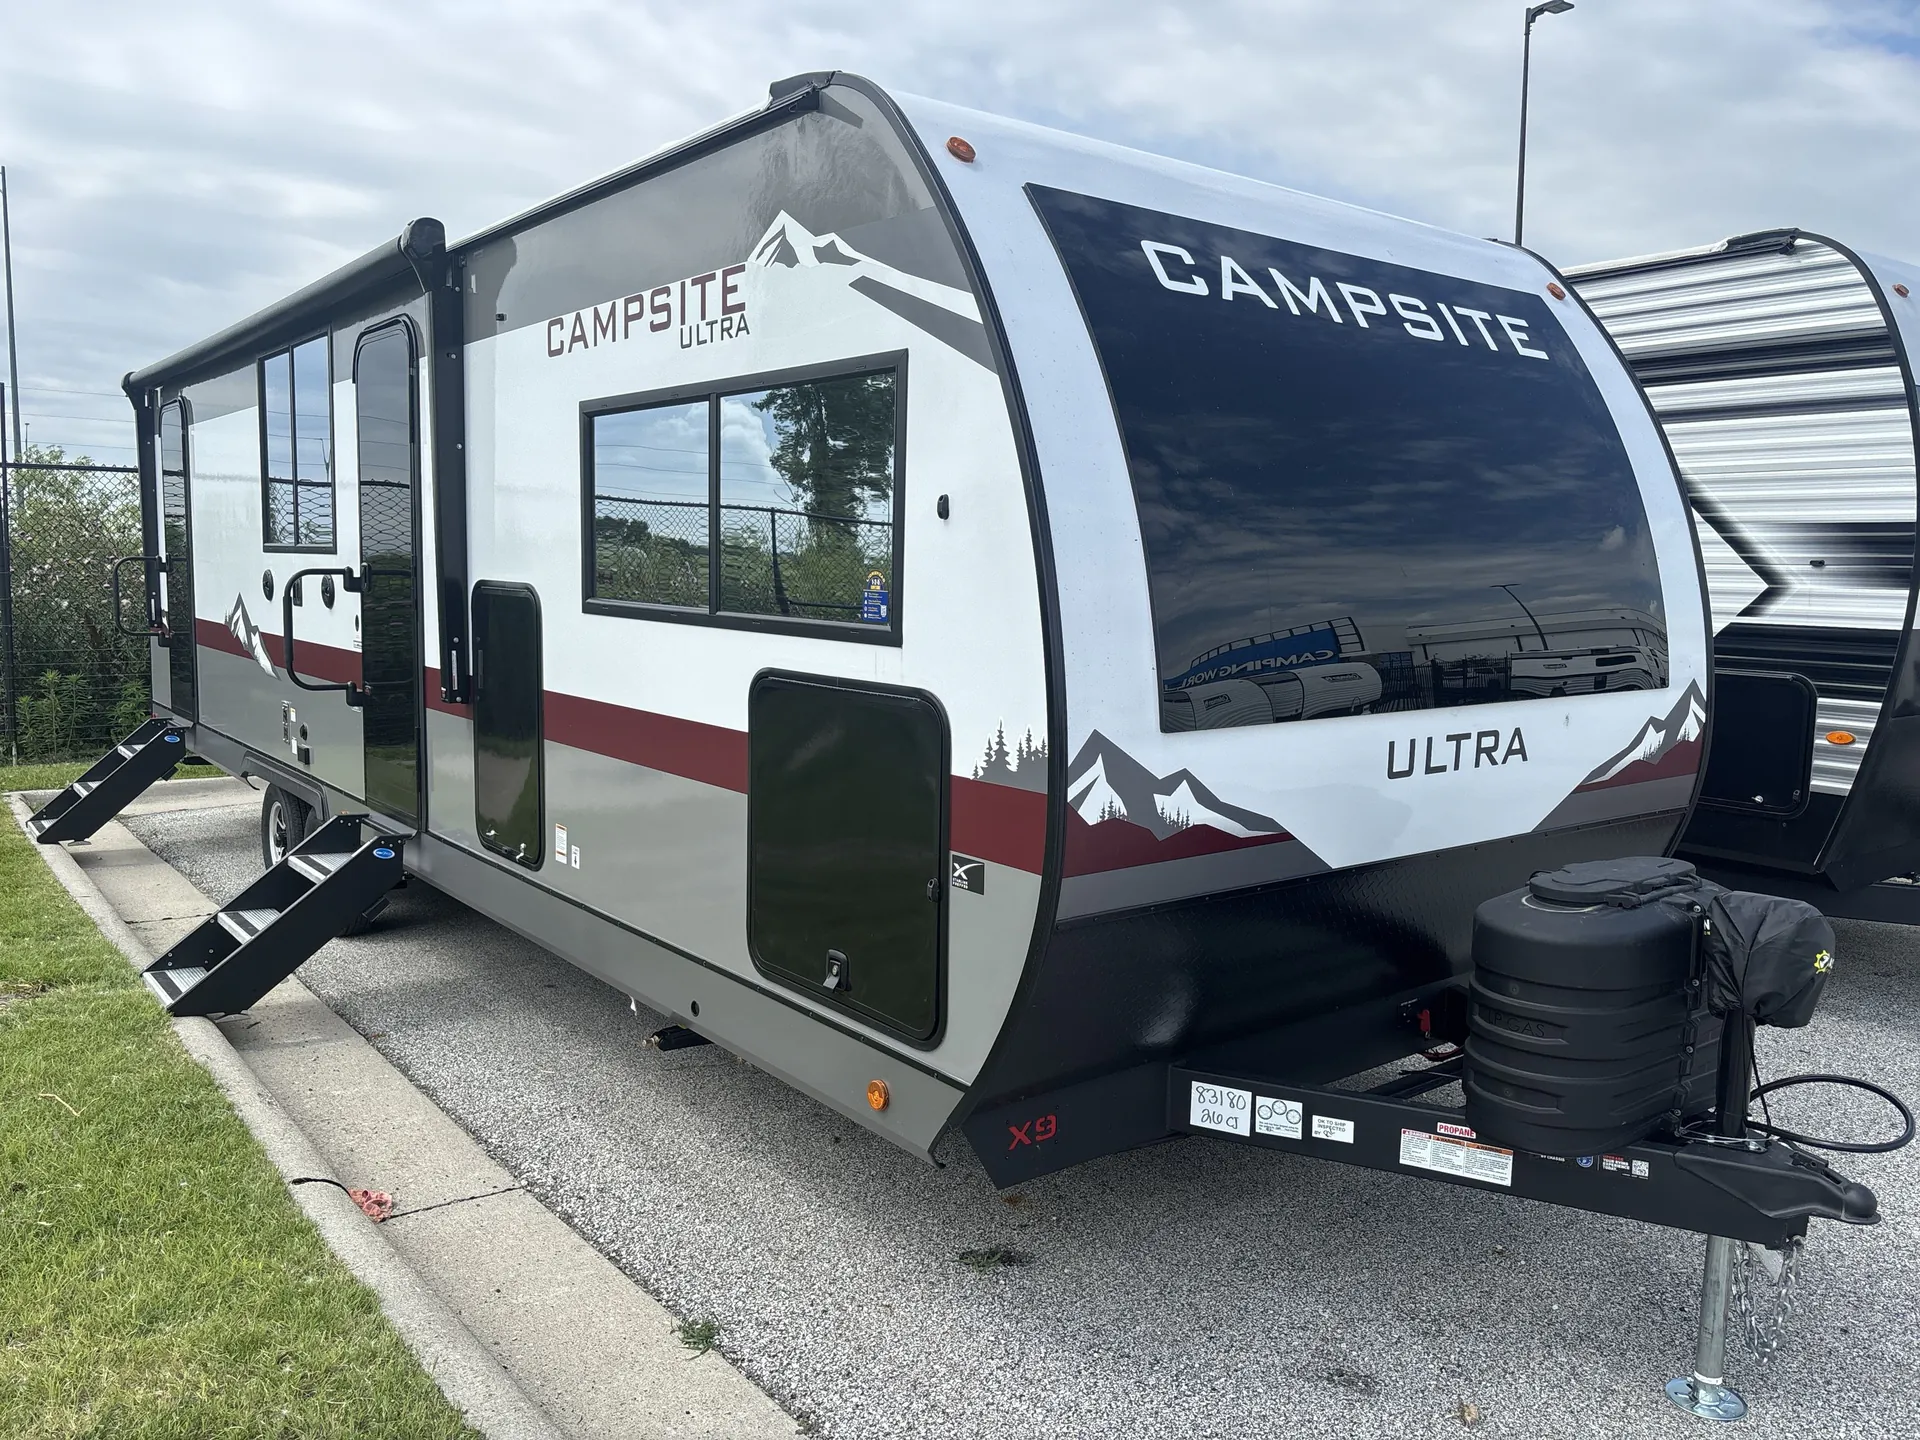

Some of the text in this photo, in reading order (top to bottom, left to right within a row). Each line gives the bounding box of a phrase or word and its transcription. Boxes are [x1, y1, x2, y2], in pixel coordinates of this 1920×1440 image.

[547, 263, 747, 358] CAMPSITE
[1140, 240, 1550, 361] CAMPSITE
[680, 312, 751, 350] ULTRA
[1387, 727, 1529, 780] ULTRA
[1507, 1018, 1545, 1038] GAS
[1195, 1085, 1247, 1111] 83180
[1008, 1114, 1057, 1151] X9
[1317, 1123, 1346, 1133] INSPECTED
[1438, 1123, 1475, 1138] PROPANE
